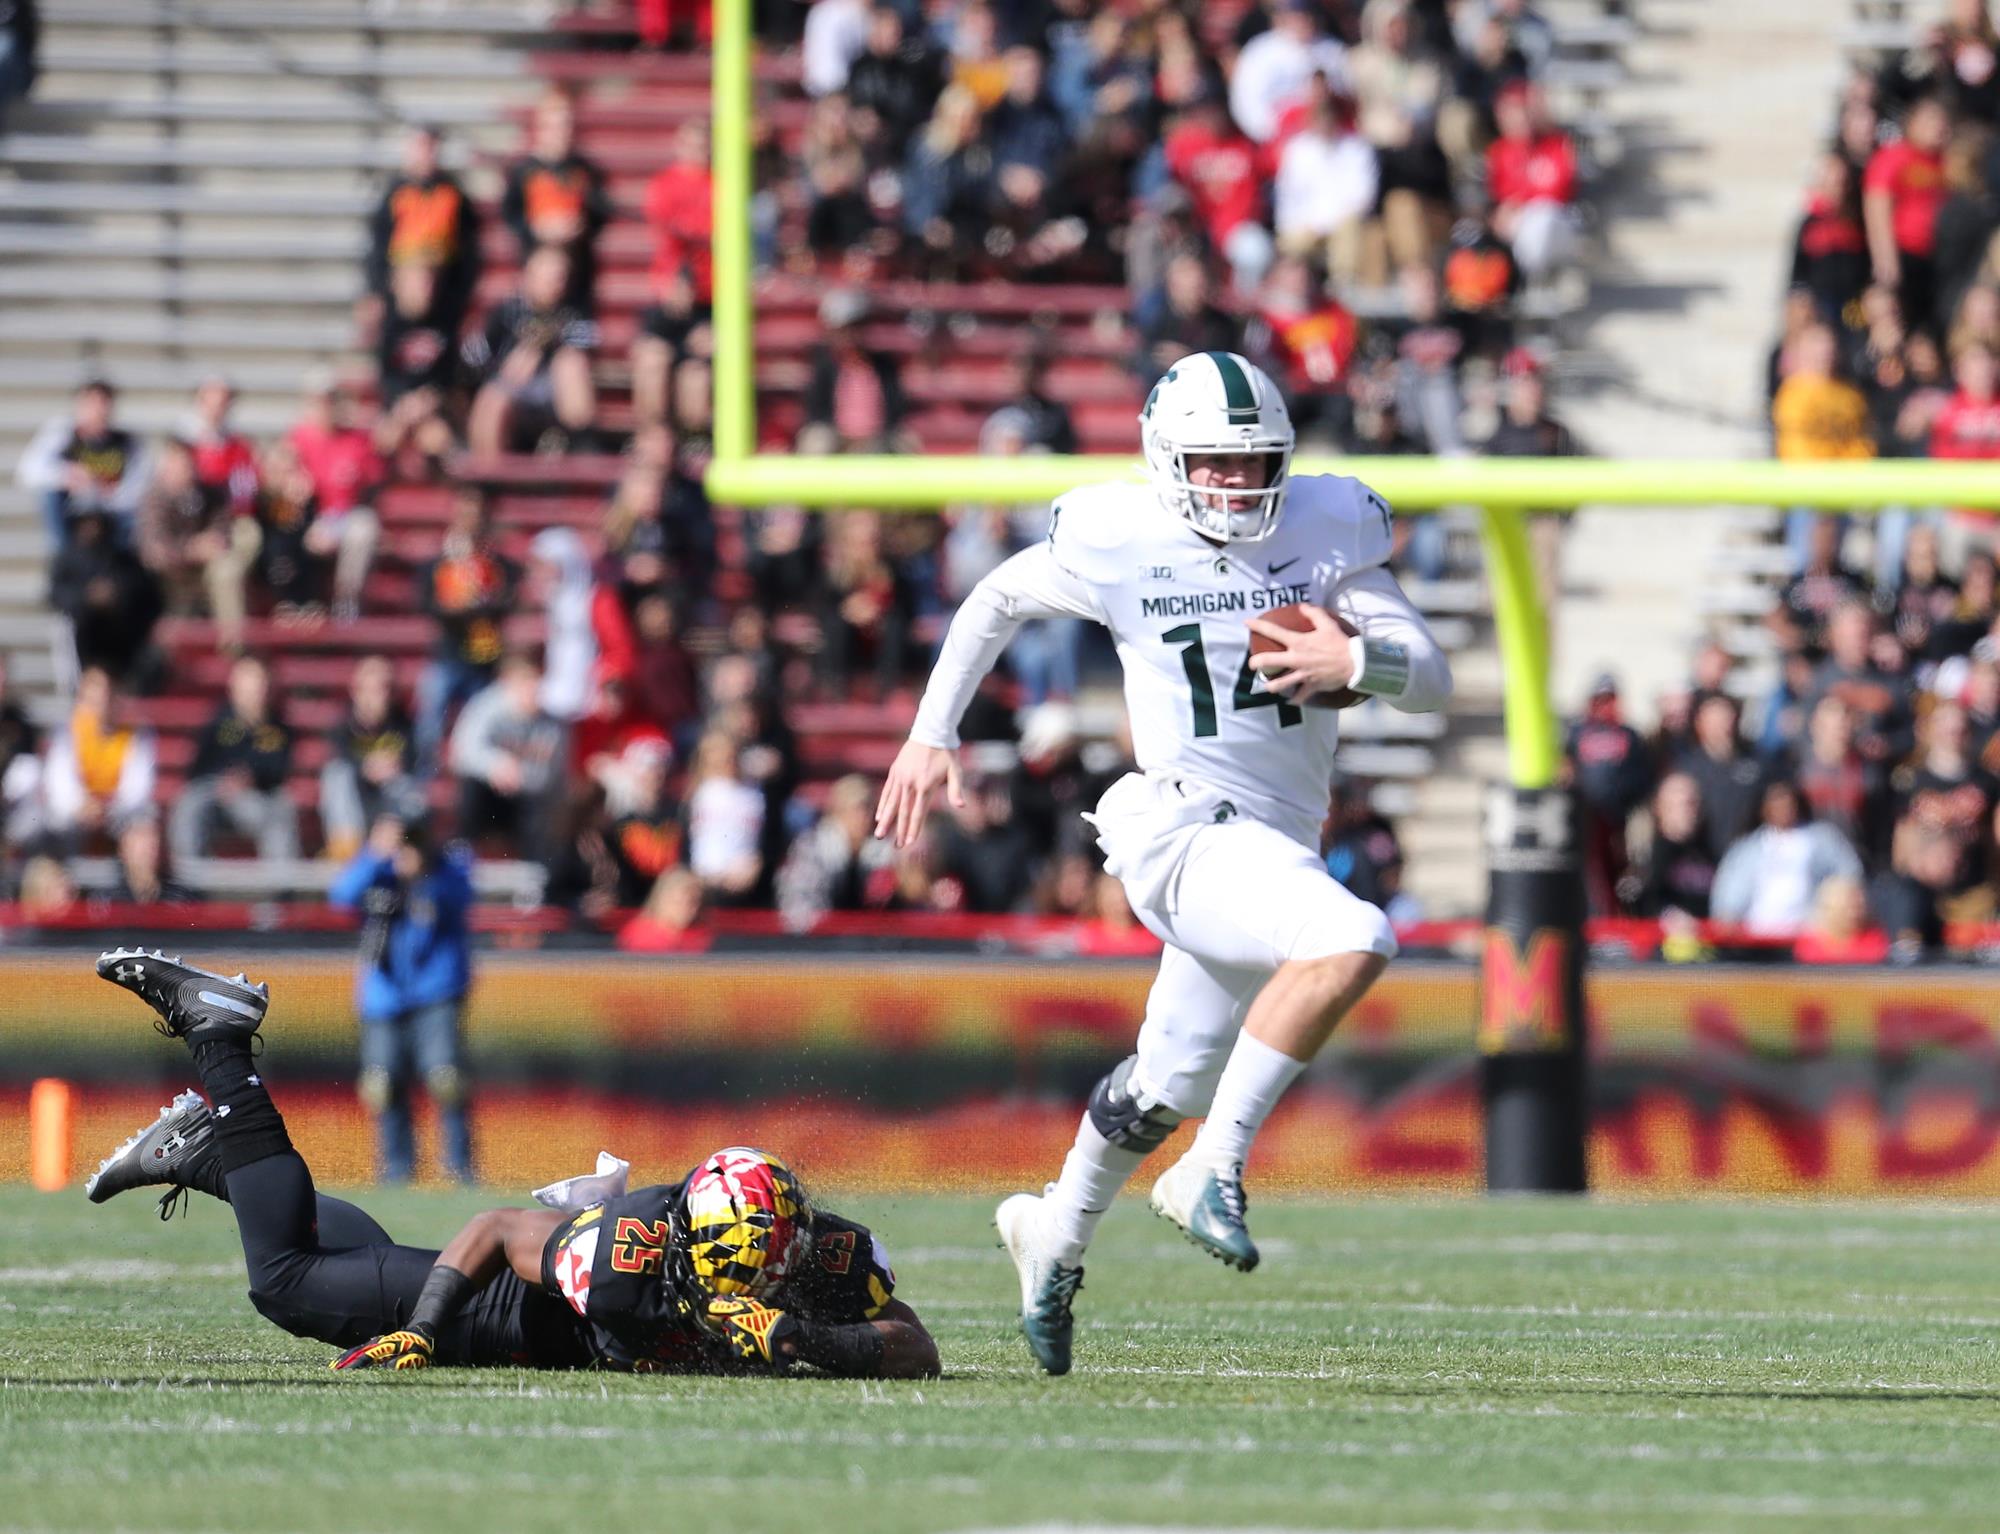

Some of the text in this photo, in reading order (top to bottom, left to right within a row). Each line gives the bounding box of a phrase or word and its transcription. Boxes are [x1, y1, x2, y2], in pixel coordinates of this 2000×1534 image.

[1141, 582, 1312, 617] MICHIGAN STATE
[611, 1216, 669, 1275] 25
